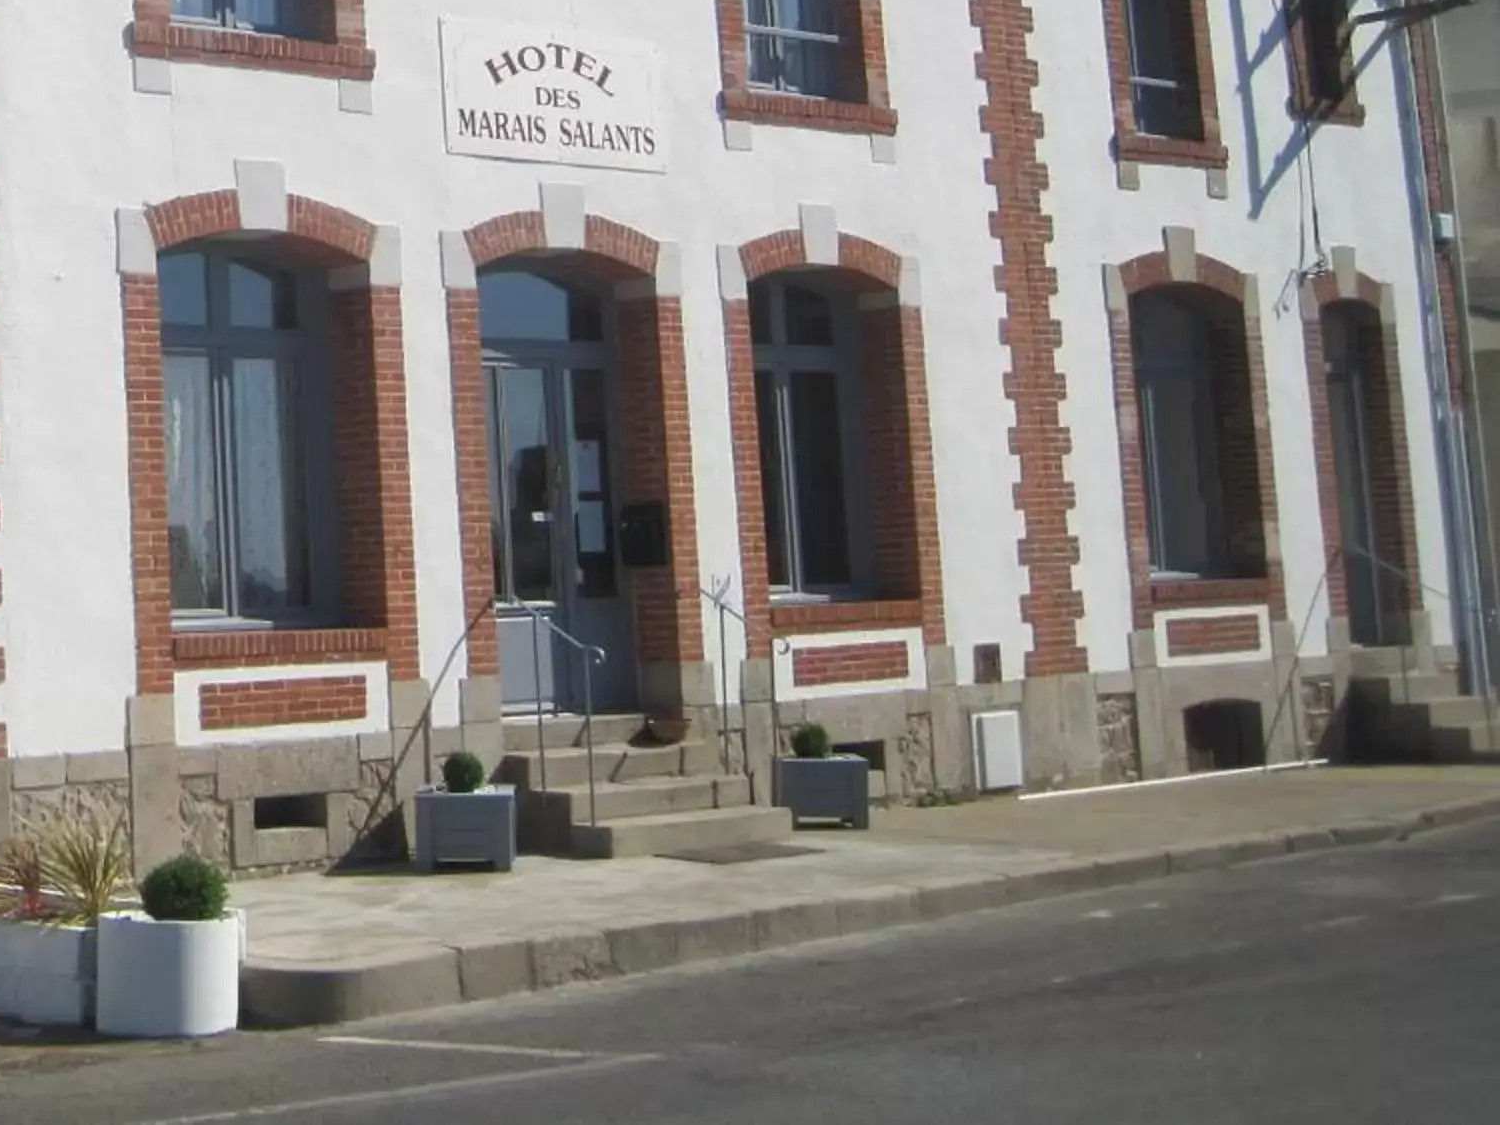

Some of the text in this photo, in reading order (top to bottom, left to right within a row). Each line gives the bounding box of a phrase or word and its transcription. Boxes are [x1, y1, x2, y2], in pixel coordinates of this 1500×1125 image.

[484, 42, 615, 97] HOTEL
[535, 86, 581, 109] DES
[458, 108, 655, 155] MARAIS SALANTS
